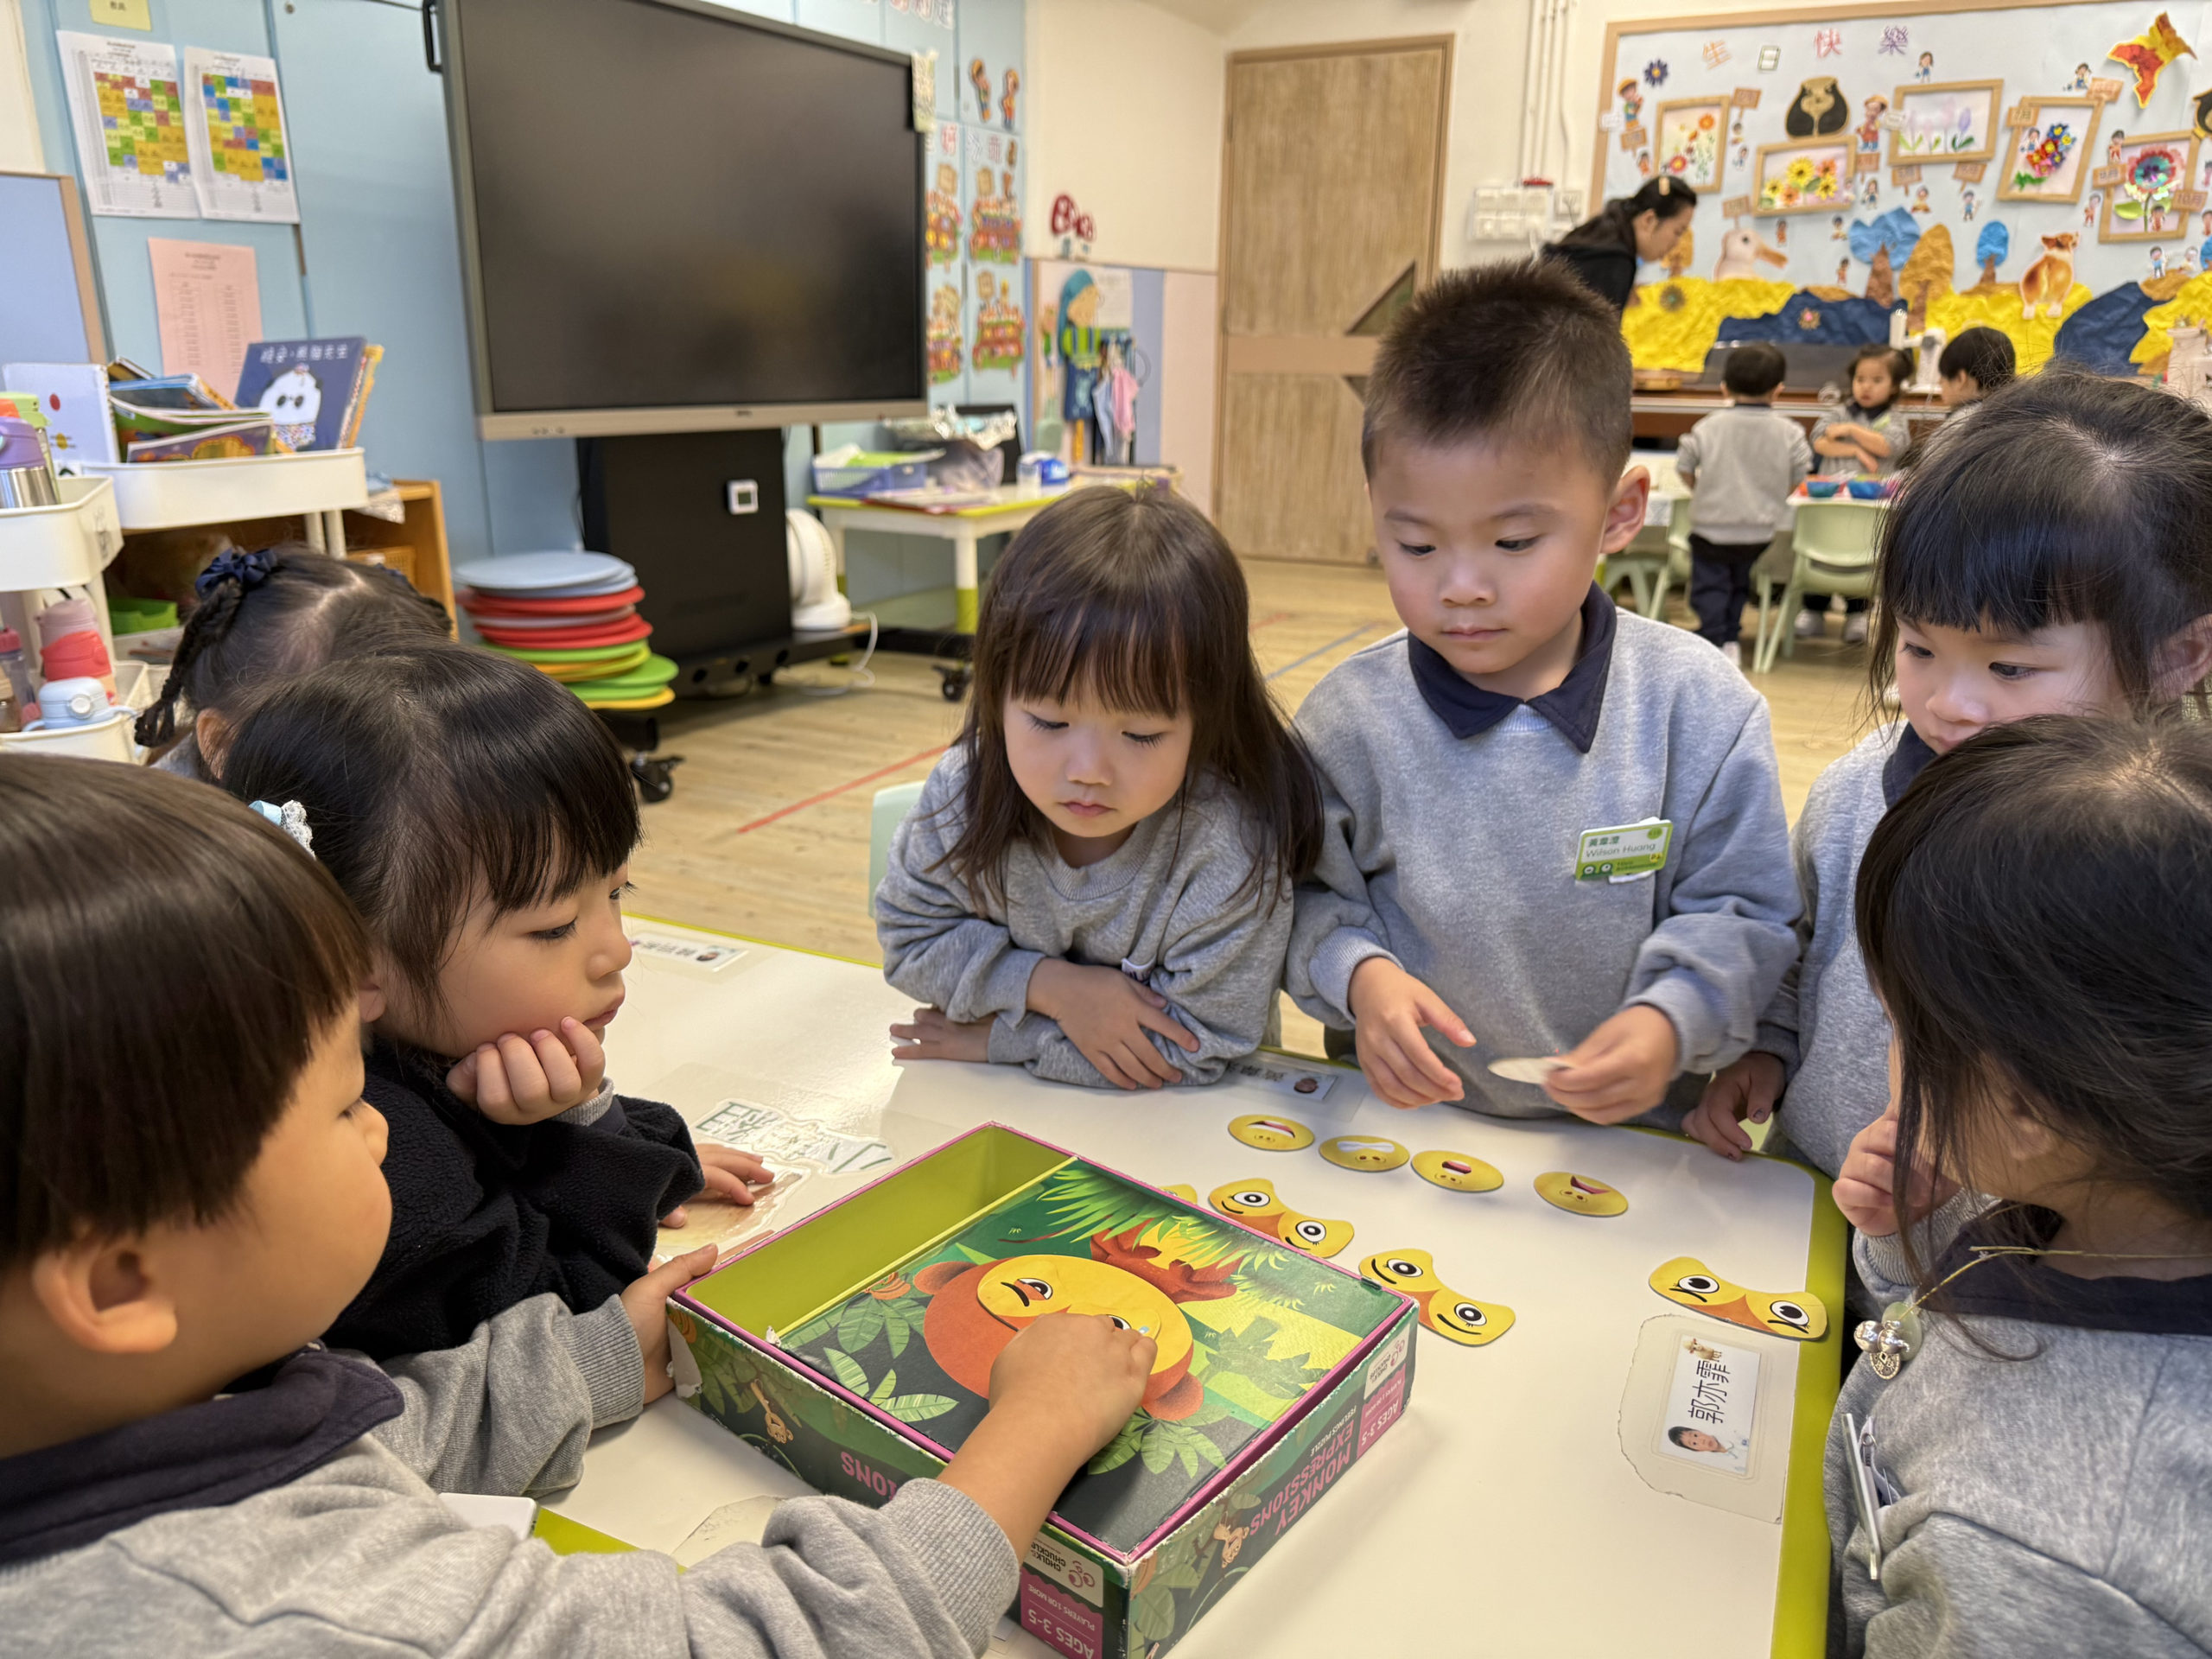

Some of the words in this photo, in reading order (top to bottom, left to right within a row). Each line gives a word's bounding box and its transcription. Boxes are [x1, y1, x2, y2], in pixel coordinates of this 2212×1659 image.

[1702, 26, 1909, 70] 生日快樂
[2177, 194, 2202, 207] 10月
[1586, 847, 1620, 858] Wilson
[1623, 842, 1656, 855] Huang
[1688, 1360, 1731, 1424] 郭亦霏
[1377, 1399, 1399, 1430] AGES
[1310, 1431, 1332, 1457] PUZZLE
[1361, 1422, 1376, 1446] 3-5
[1249, 1420, 1354, 1535] EXPRESSIONS
[1275, 1443, 1351, 1536] MONKEY
[1027, 1584, 1047, 1600] MORE
[1028, 1609, 1052, 1634] 3-5
[1064, 1605, 1095, 1631] PLAYERS
[1055, 1627, 1094, 1659] AGES
